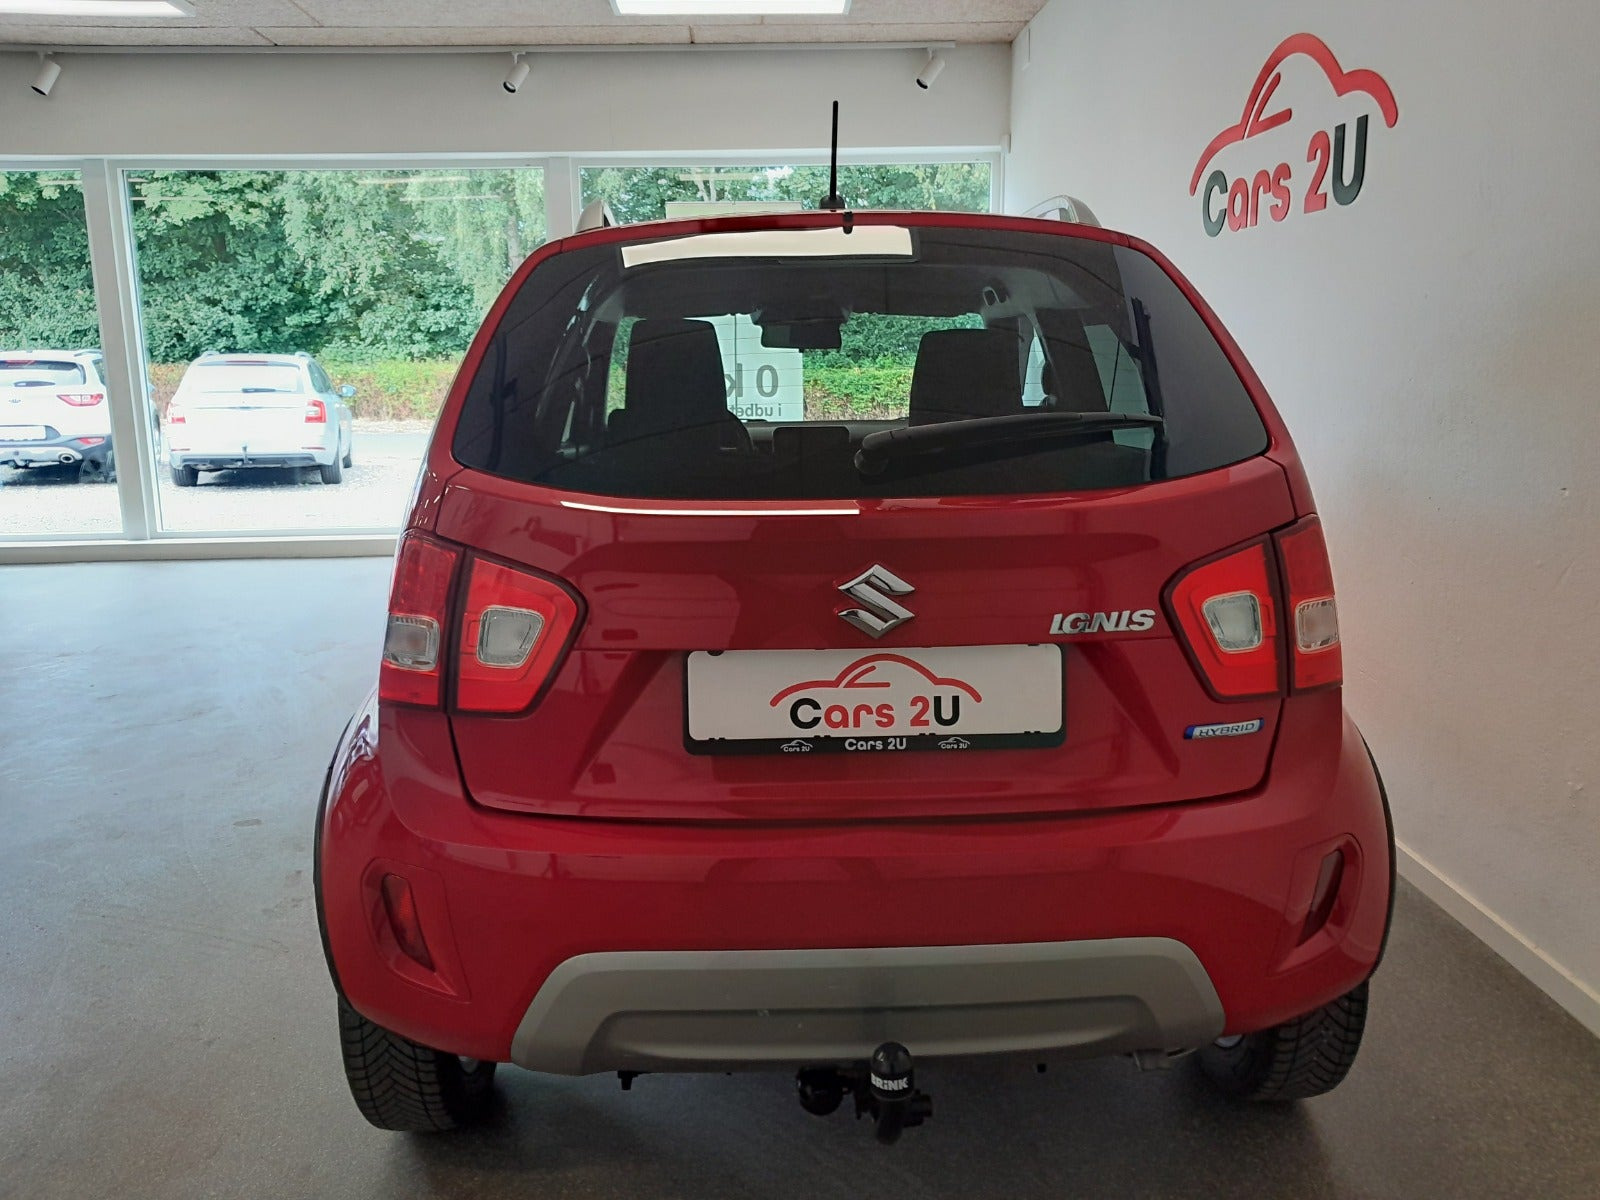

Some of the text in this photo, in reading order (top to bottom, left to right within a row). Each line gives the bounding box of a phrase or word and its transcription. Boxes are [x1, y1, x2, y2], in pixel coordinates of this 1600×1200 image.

[1202, 114, 1369, 238] Cars 2U
[1049, 609, 1156, 635] IGNIS
[789, 694, 960, 730] Cars 2U
[1198, 722, 1255, 737] HYBRID
[844, 737, 907, 751] Cars 2U
